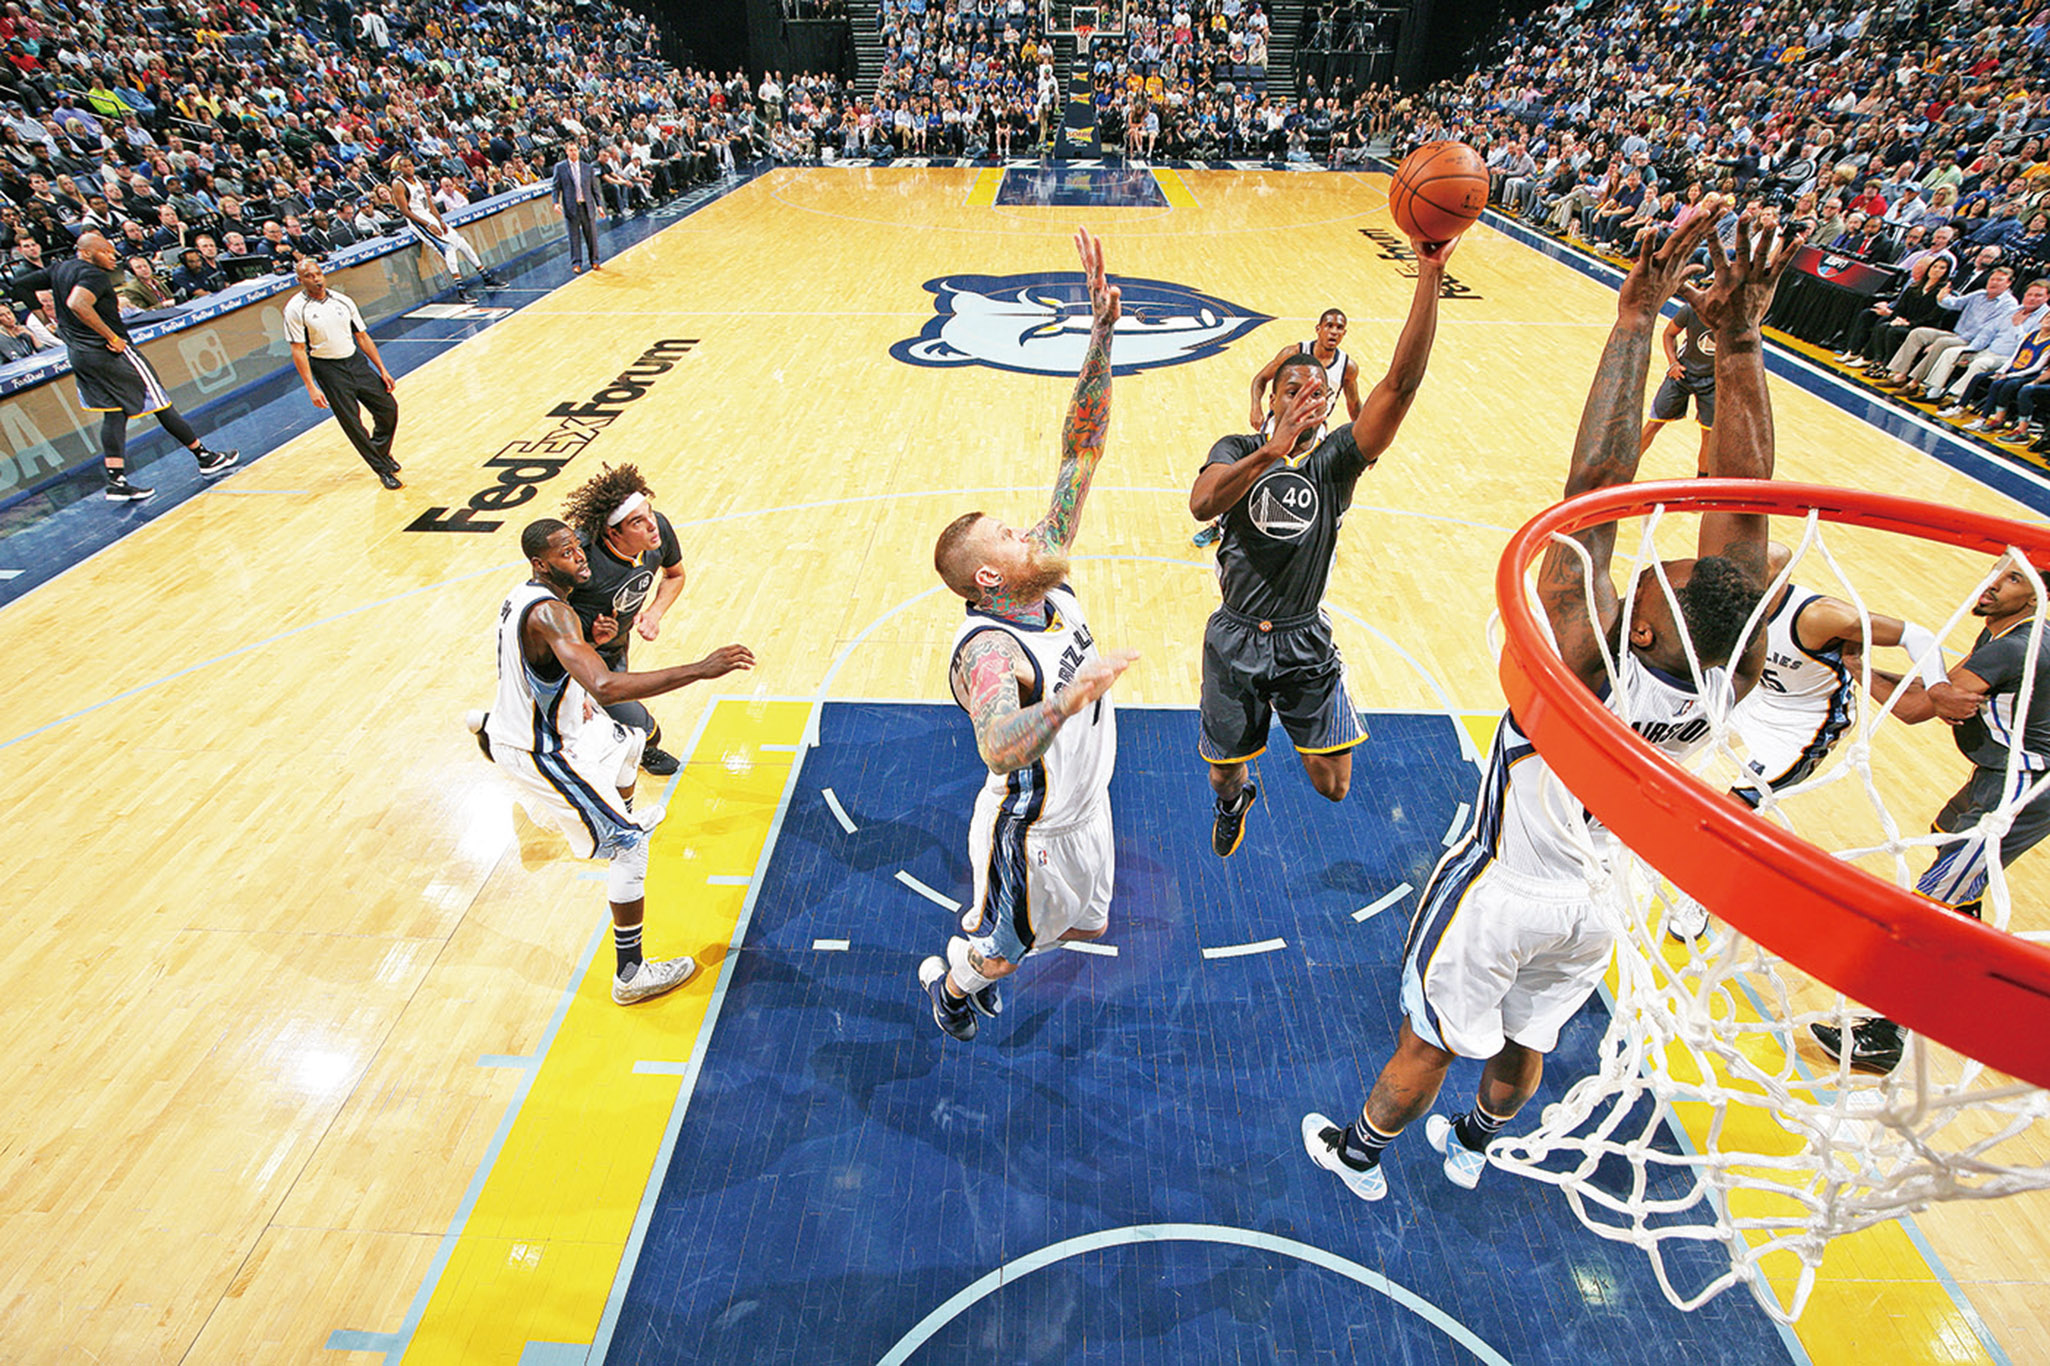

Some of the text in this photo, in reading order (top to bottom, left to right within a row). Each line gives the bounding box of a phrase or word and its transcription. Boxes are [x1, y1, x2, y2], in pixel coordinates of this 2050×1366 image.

[10, 369, 46, 389] FanDuel
[402, 338, 701, 534] FedExForum
[1282, 486, 1312, 509] 40
[638, 575, 650, 591] 18
